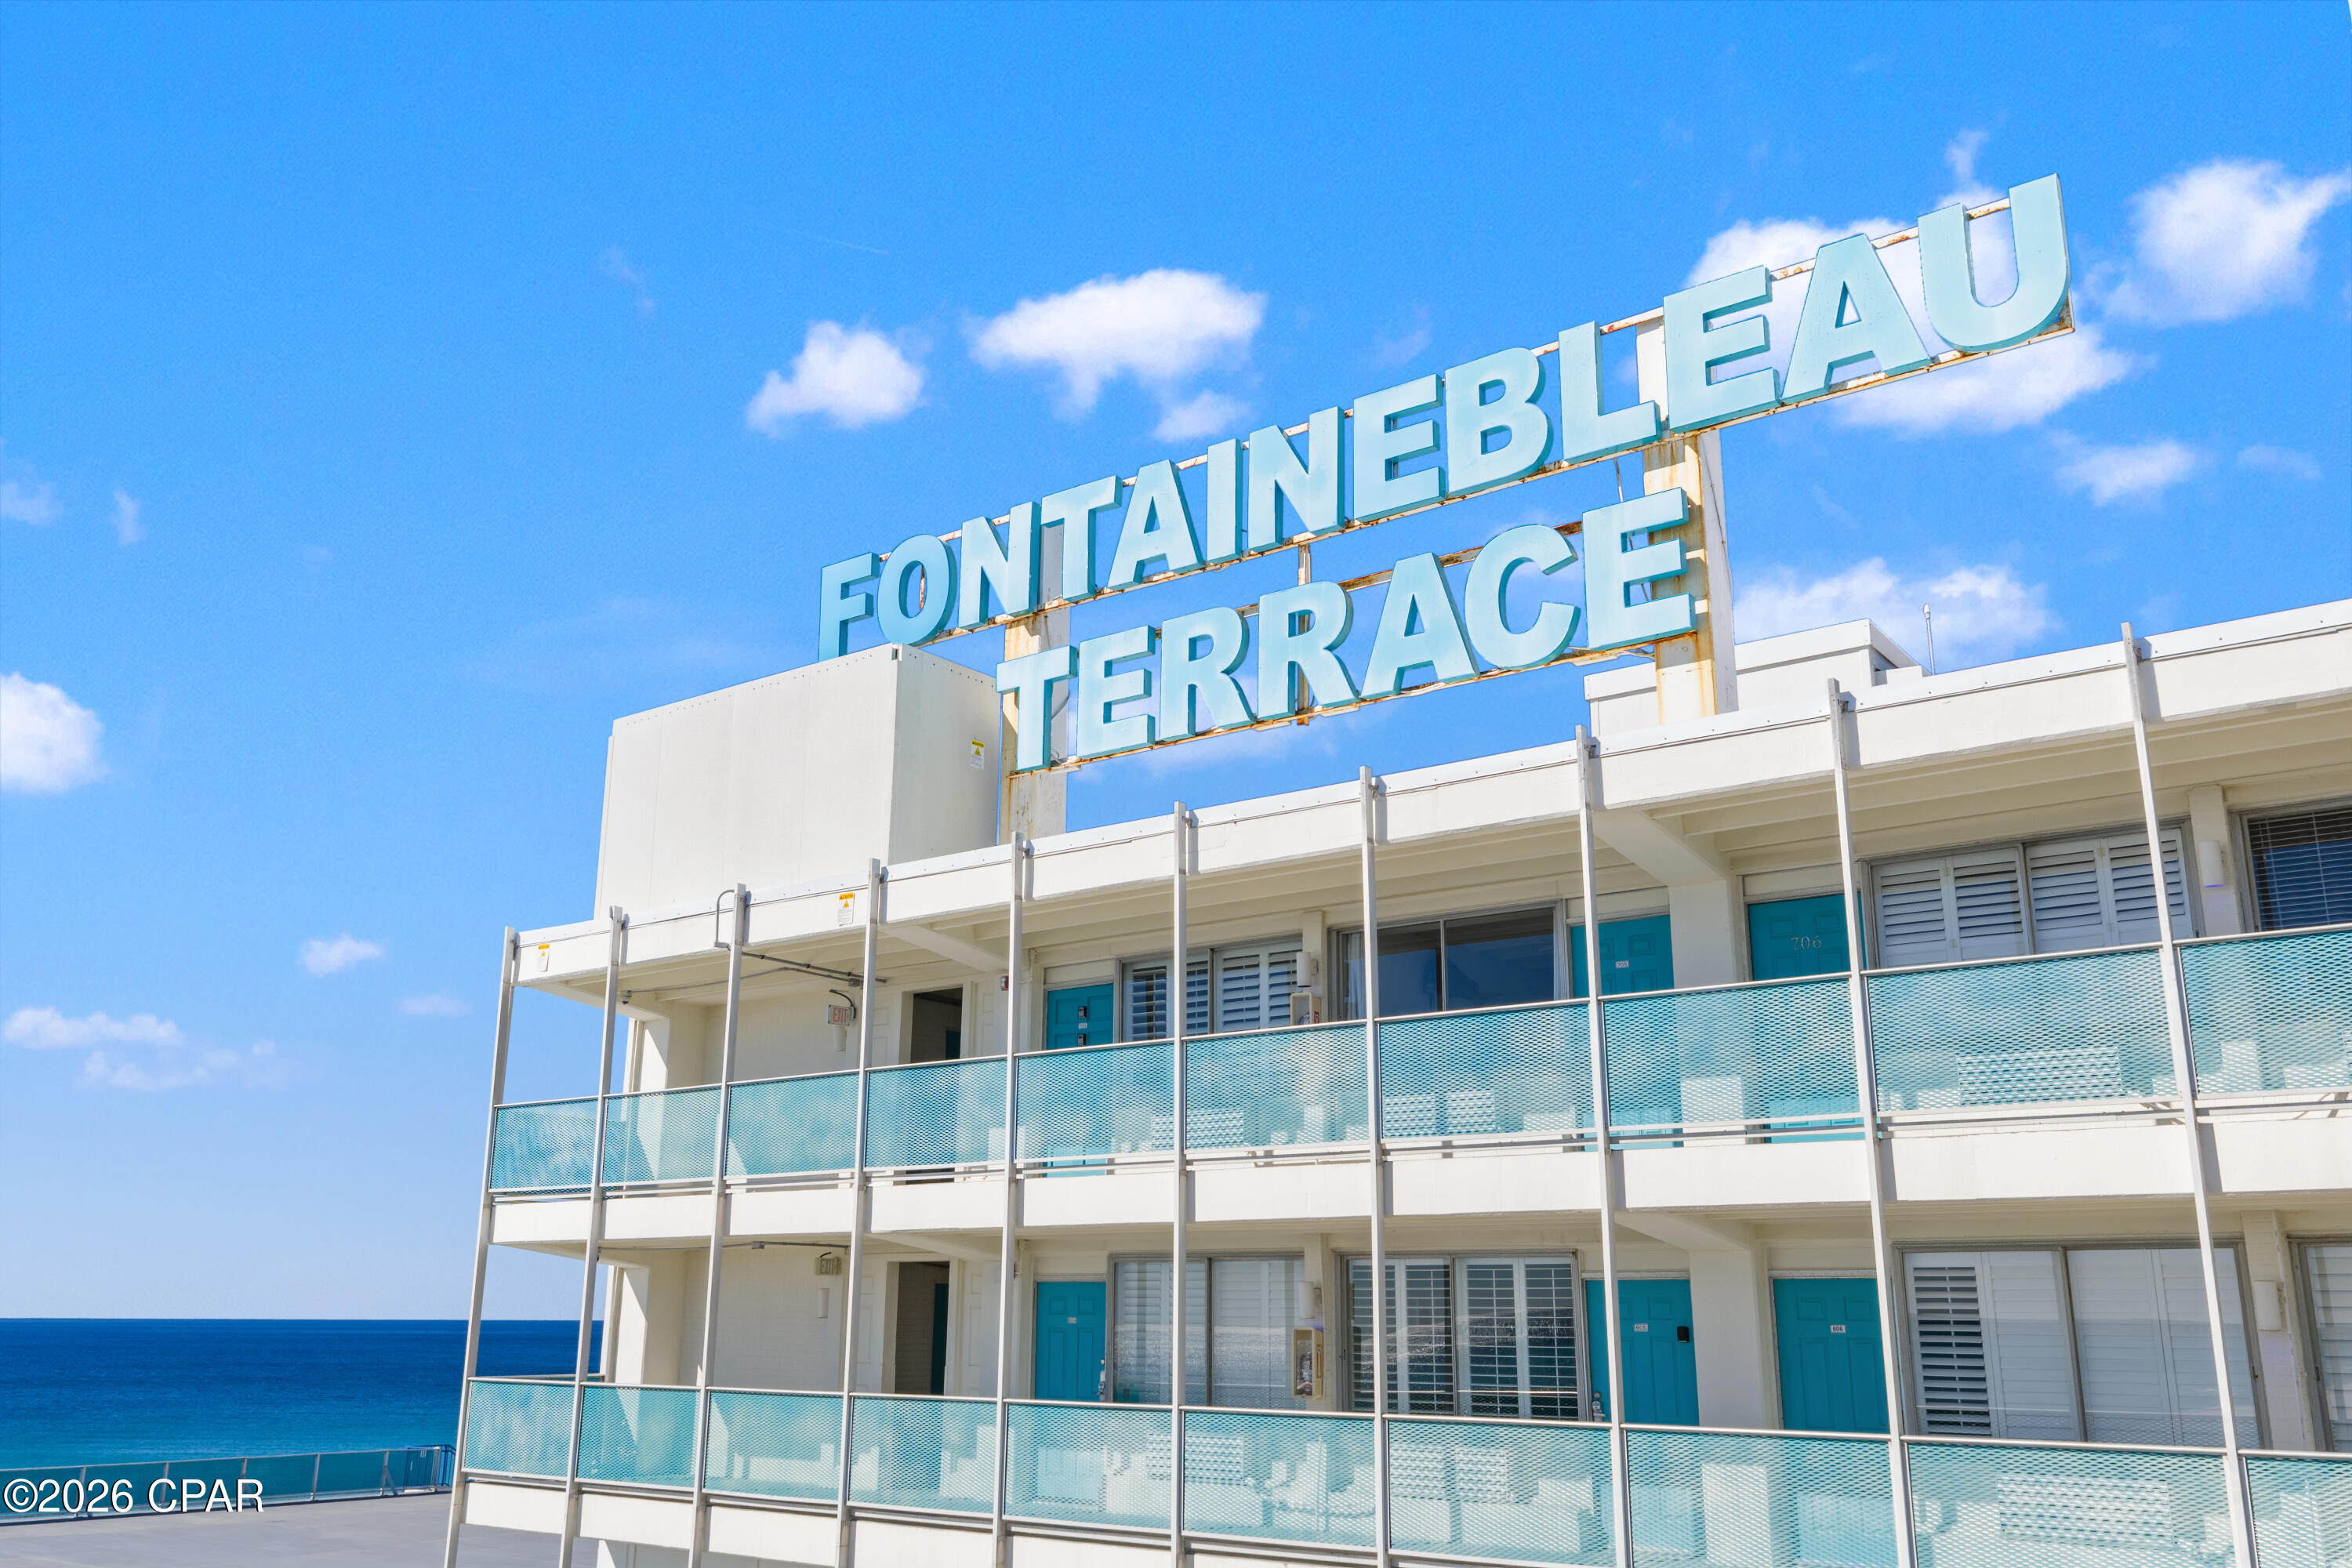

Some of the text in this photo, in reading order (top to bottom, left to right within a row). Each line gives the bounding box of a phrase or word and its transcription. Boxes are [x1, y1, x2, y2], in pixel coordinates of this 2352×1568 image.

[818, 172, 2071, 662] FONTAINEBLEAU
[996, 486, 1697, 772] TERRACE
[1790, 935, 1822, 950] 706
[833, 1007, 848, 1023] EXIT
[819, 1258, 836, 1275] EXIT
